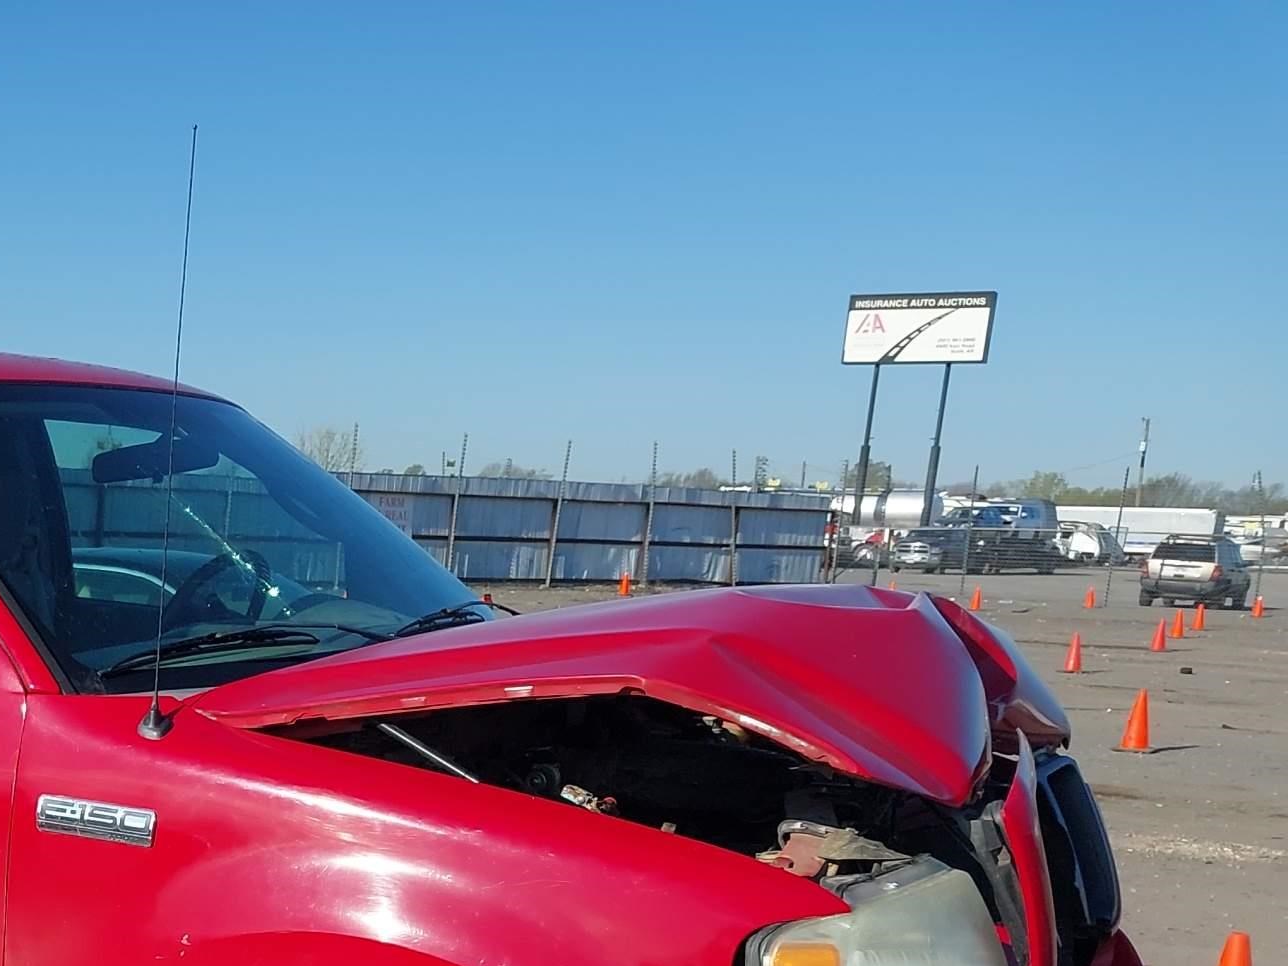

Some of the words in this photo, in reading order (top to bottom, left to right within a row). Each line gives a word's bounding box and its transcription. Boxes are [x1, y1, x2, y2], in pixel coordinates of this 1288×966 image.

[855, 299, 908, 308] INSURANCE
[910, 298, 936, 307] AUTO
[937, 297, 987, 306] AUCTIONS
